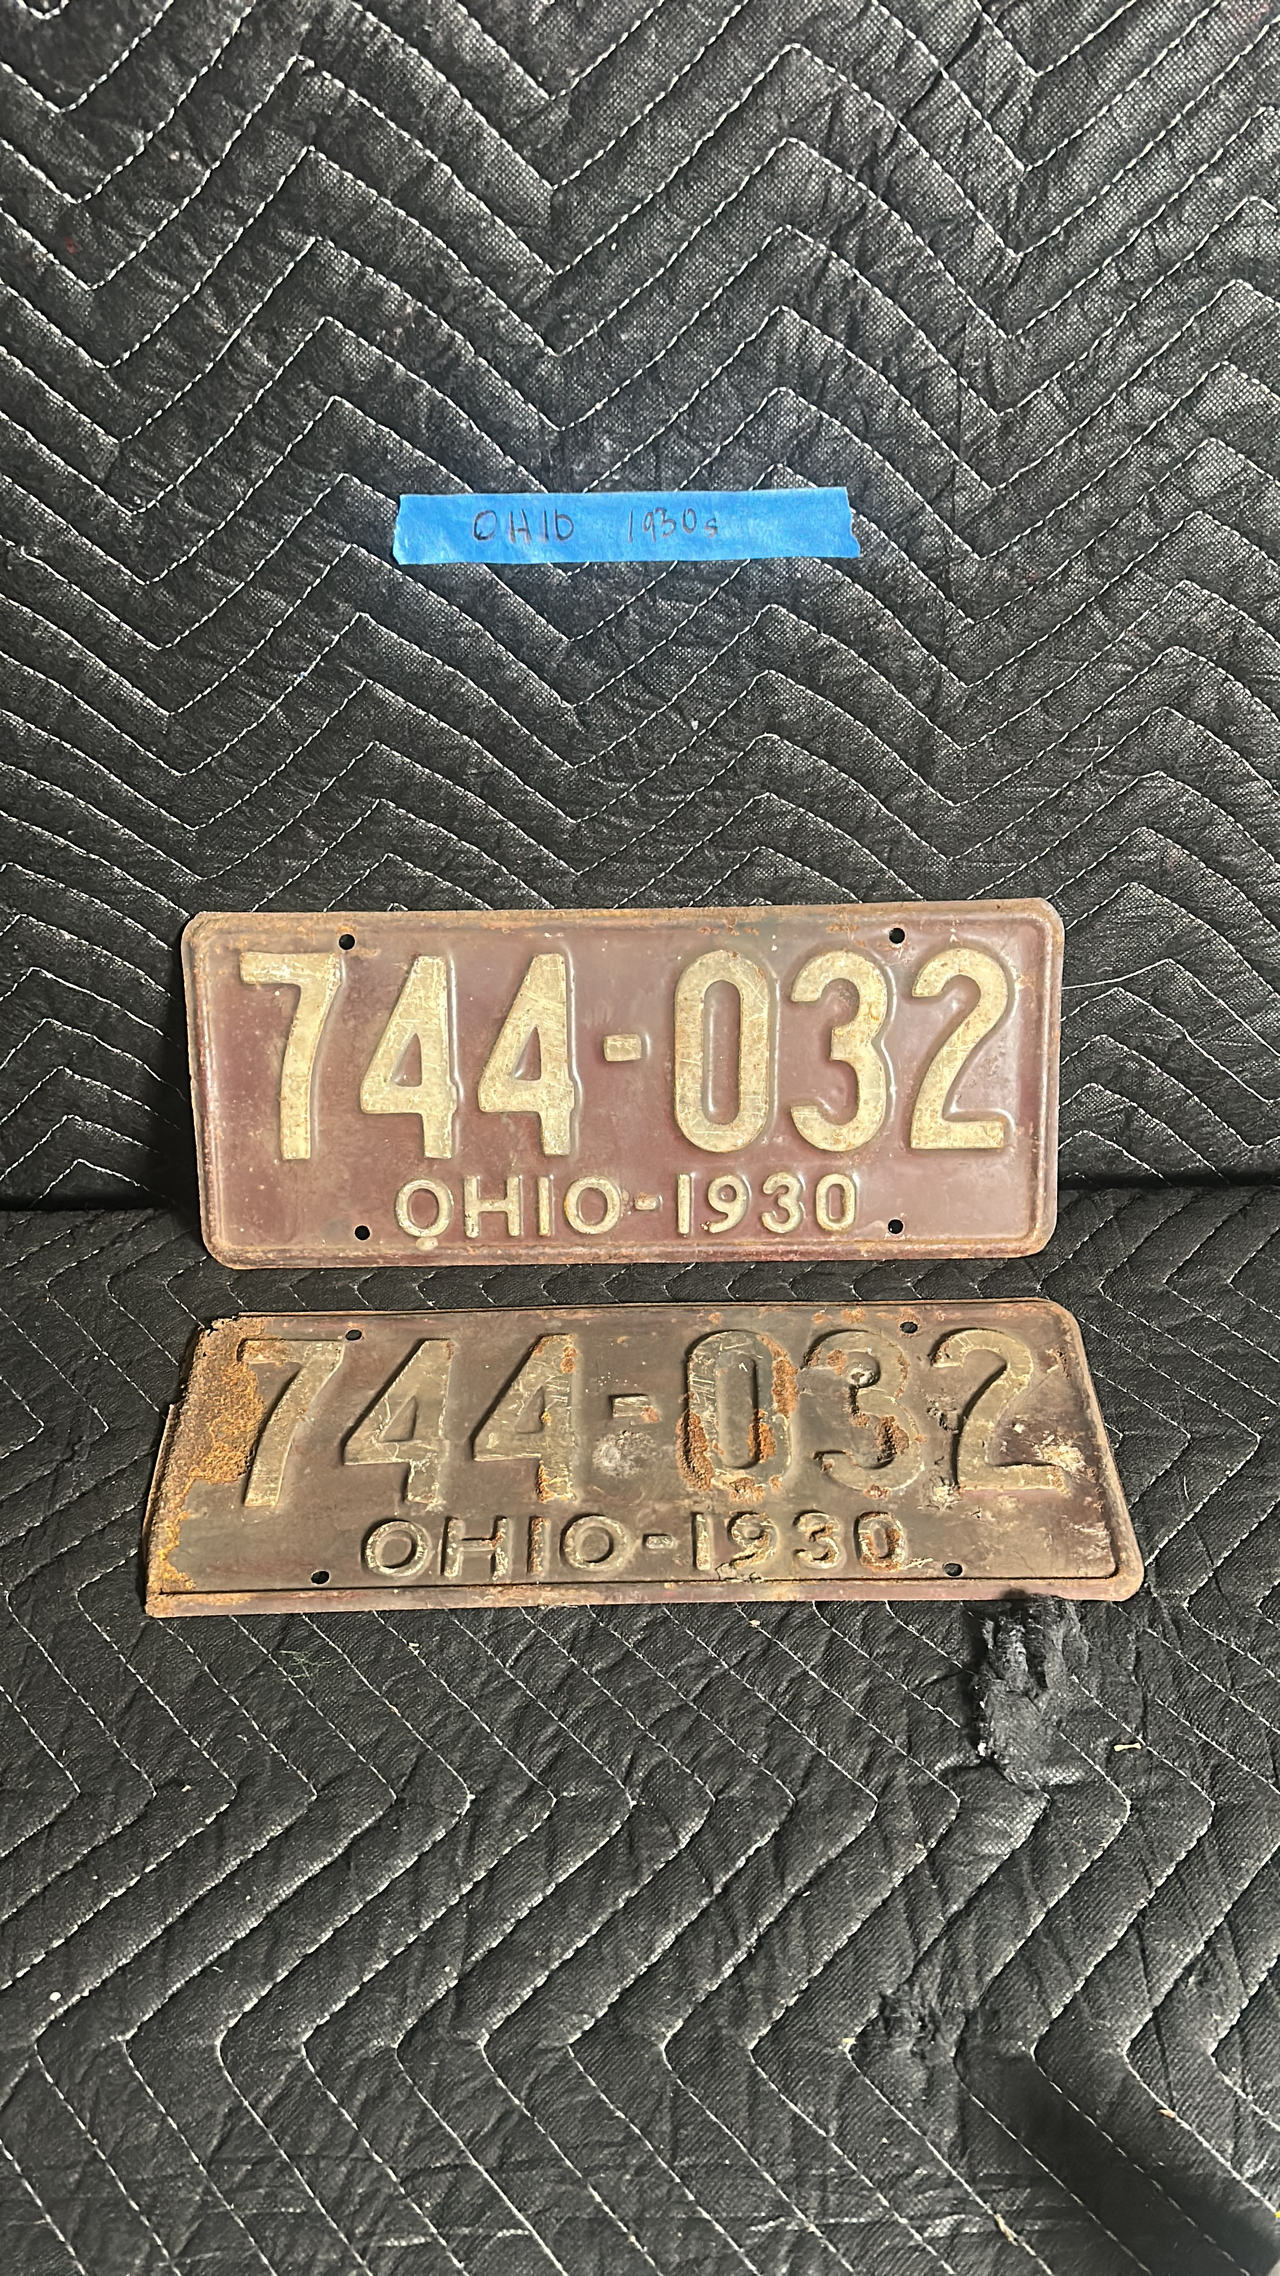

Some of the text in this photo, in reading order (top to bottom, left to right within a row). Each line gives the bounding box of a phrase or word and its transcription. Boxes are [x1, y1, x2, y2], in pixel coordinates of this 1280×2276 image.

[628, 507, 719, 544] 1930s
[239, 947, 1010, 1161] 744-032
[395, 1172, 858, 1238] OHIO-1930
[236, 1326, 1069, 1508] 744-032
[362, 1510, 909, 1577] OHIO-1930
